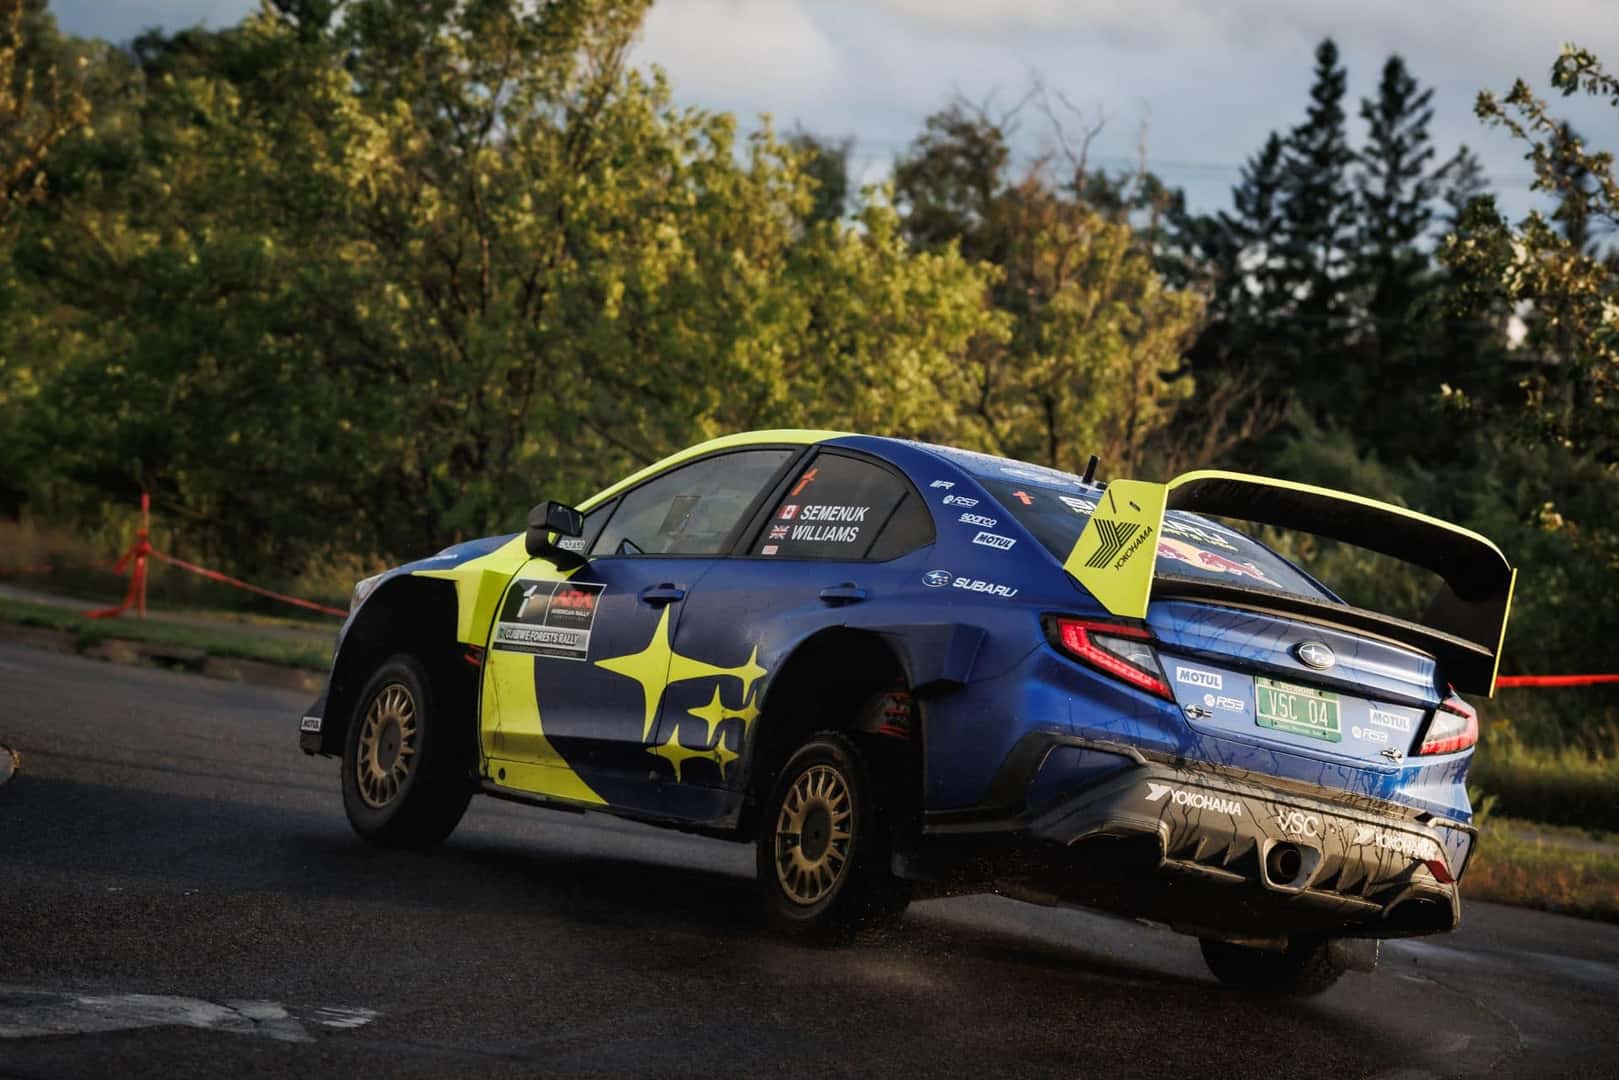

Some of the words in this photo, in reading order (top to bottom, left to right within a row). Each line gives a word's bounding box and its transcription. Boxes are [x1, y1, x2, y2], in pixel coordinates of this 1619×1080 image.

[800, 504, 870, 522] SEMENUK
[791, 525, 860, 543] WILLIAMS
[976, 533, 1013, 548] MOTUL
[1113, 526, 1153, 571] YOKOHAMA
[952, 577, 1018, 598] SUBARU
[517, 584, 538, 618] 1
[1179, 669, 1221, 687] MOTUL
[1268, 690, 1298, 720] VSC
[1308, 699, 1328, 727] 04
[1372, 711, 1409, 729] MOTUL
[1169, 789, 1242, 816] YOKOHAMA
[1278, 809, 1318, 837] VSC
